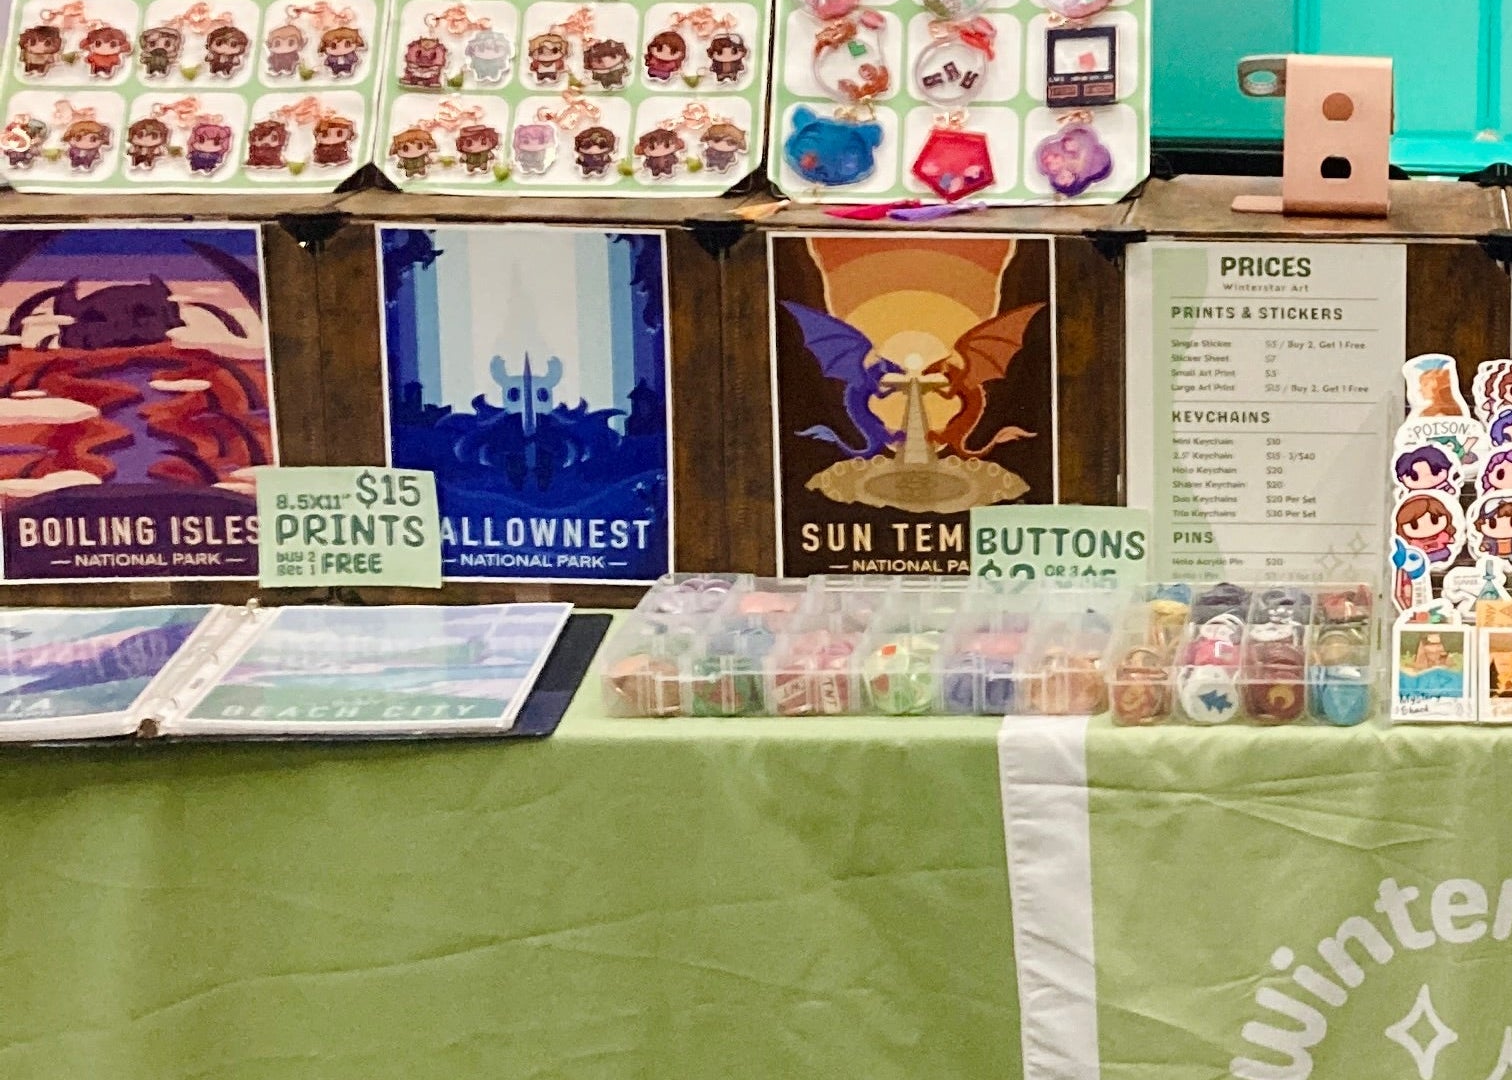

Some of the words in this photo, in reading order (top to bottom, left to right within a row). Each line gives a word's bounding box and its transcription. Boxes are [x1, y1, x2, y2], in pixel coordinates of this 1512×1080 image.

[1220, 256, 1312, 278] PRICES
[1222, 283, 1286, 292] Winterstar
[1291, 283, 1309, 292] Art
[1171, 306, 1236, 319] PRINTS
[1241, 307, 1252, 319] &
[1258, 307, 1343, 320] STICKERS
[1287, 341, 1304, 350] Buy
[1319, 341, 1335, 349] Get
[1345, 341, 1366, 349] Free
[1172, 410, 1271, 424] KEYCHAINS
[1412, 421, 1471, 438] POISON
[355, 469, 422, 510] $15
[19, 516, 156, 548] BOILING
[171, 515, 260, 546] ISLES
[275, 513, 425, 548] PRINTS
[441, 516, 651, 550] ALLOWNEST
[801, 523, 873, 553] SUN
[891, 522, 964, 553] TEM
[1173, 530, 1215, 544] PINS
[976, 526, 1146, 561] BUTTONS
[75, 552, 168, 567] NATIONAL
[172, 552, 221, 567] PARK
[307, 551, 316, 563] 2
[320, 552, 383, 575] FREE
[460, 553, 553, 568] NATIONAL
[556, 554, 606, 569] PARK
[852, 558, 939, 573] NATIONAL
[947, 559, 970, 572] PA
[384, 703, 479, 718] CITY
